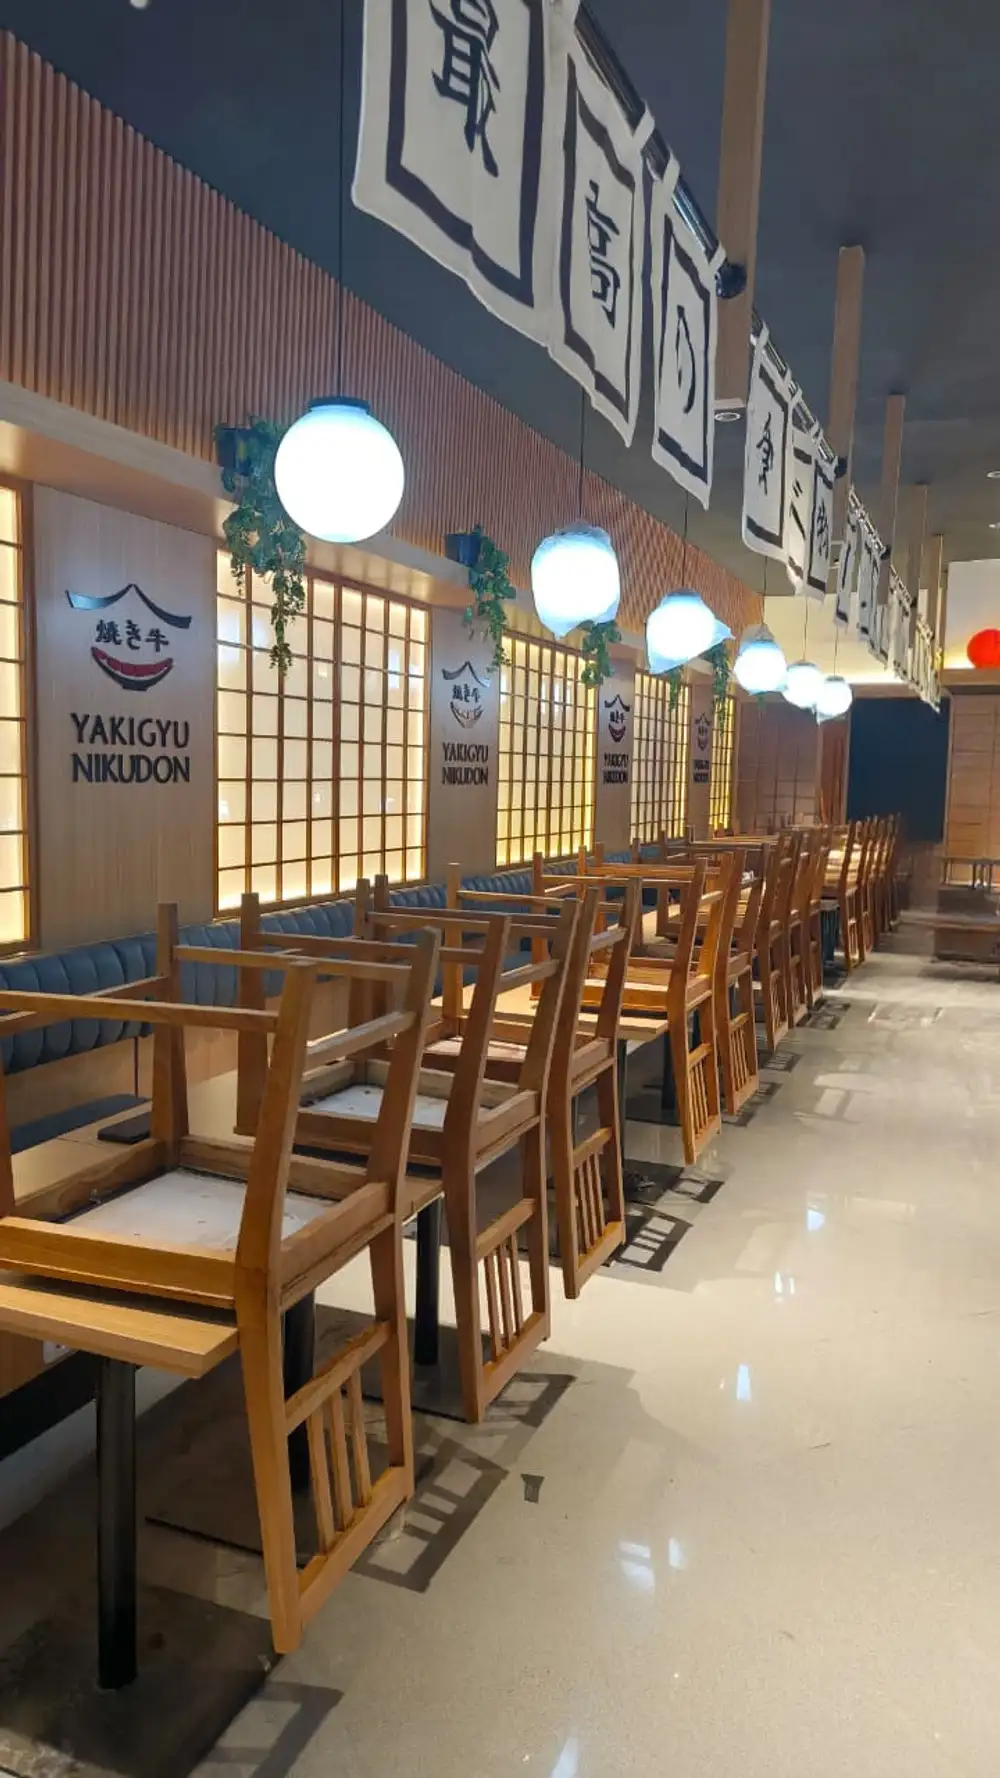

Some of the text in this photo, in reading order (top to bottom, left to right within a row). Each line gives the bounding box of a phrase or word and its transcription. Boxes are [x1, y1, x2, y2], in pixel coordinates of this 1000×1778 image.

[586, 179, 622, 329] 高
[95, 619, 170, 652] 焼き牛
[71, 713, 190, 748] YAKIGYU
[72, 754, 190, 783] NIKUDON
[443, 743, 489, 763] YAKIGYU
[442, 767, 489, 786] NIKUDON
